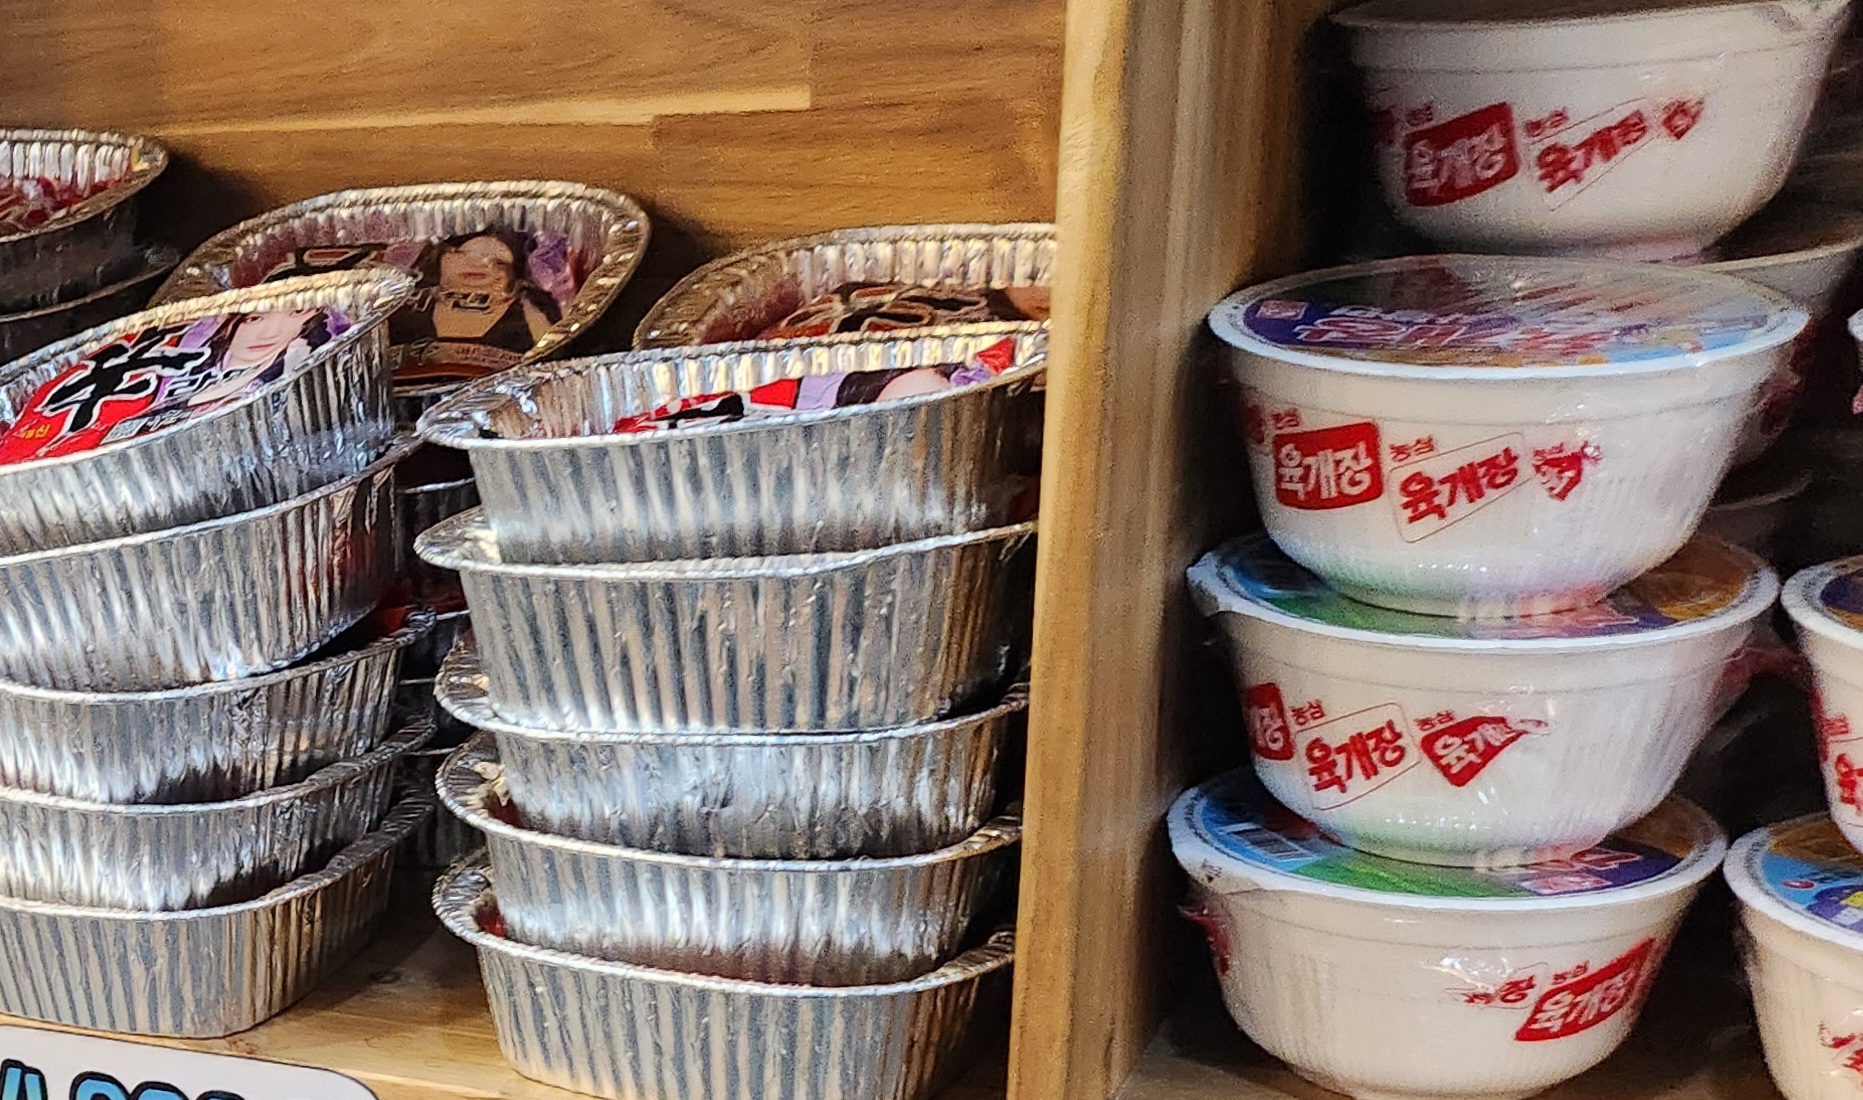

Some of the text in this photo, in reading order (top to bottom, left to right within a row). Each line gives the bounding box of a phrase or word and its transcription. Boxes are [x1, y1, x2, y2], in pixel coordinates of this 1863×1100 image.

[1277, 441, 1373, 501] 육개장
[1399, 446, 1519, 524] 육개장
[1291, 699, 1326, 727] 농심
[1305, 718, 1407, 794] 육개장
[1435, 721, 1509, 774] 육개
